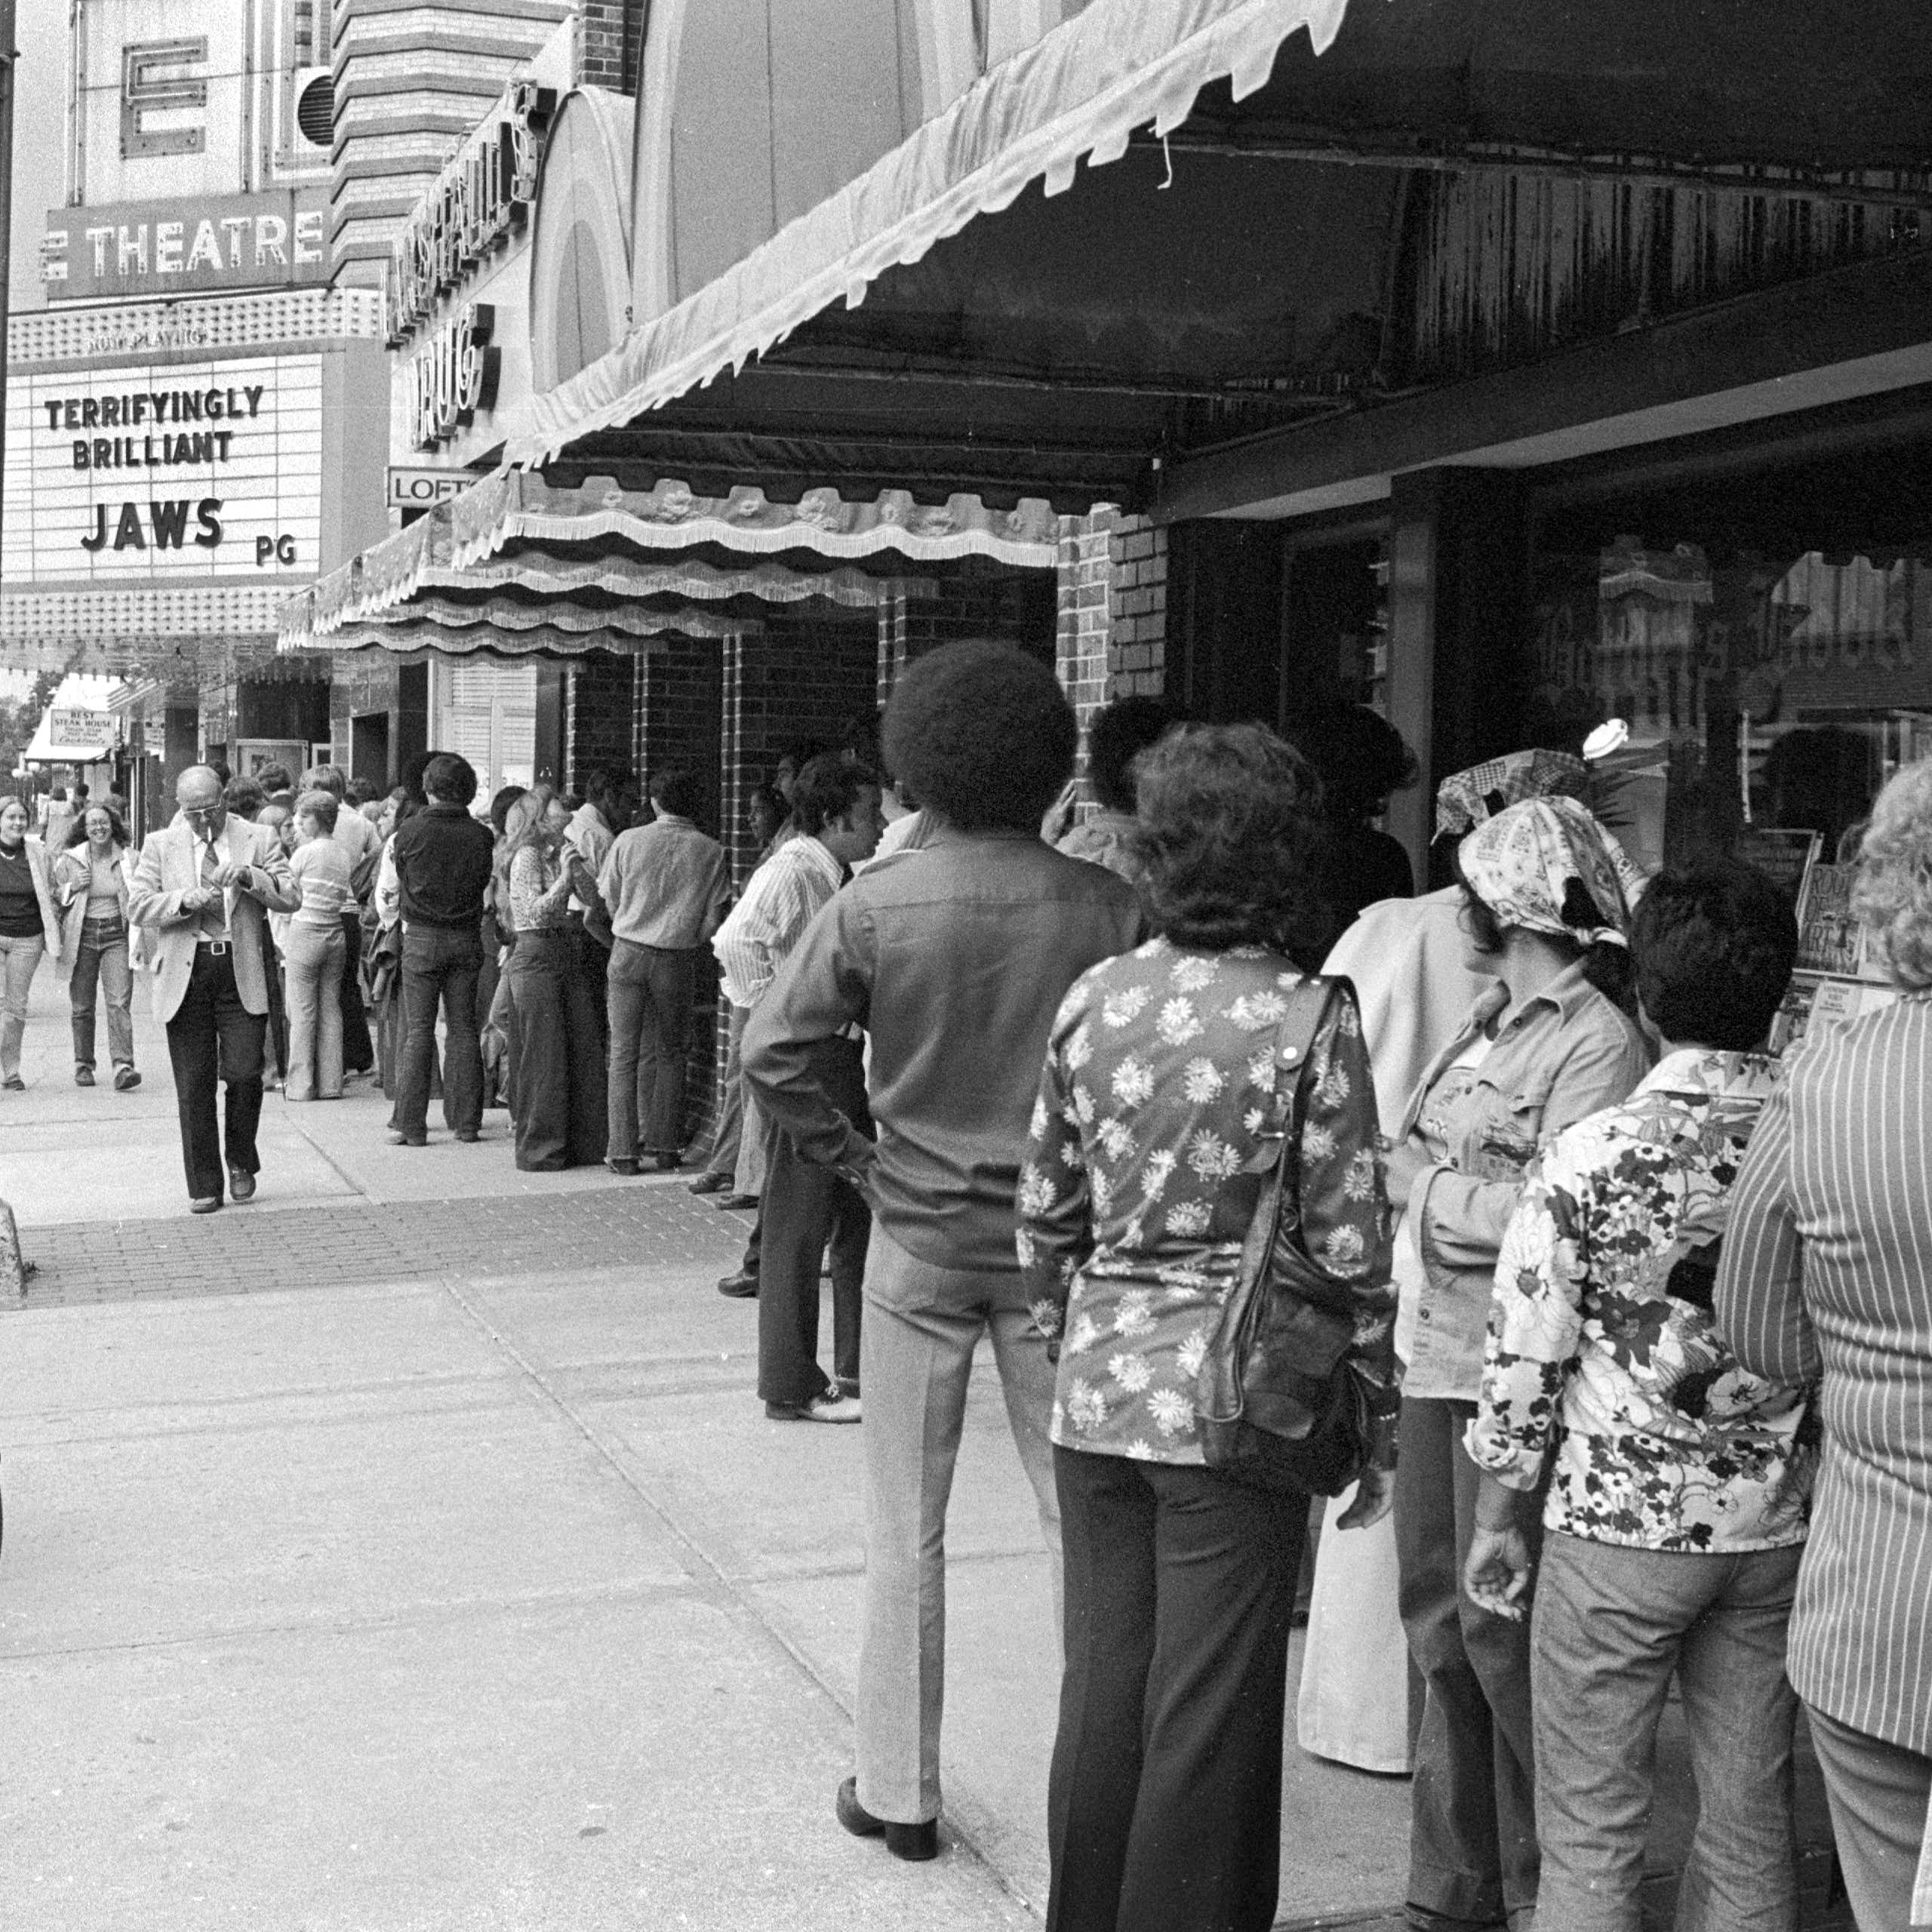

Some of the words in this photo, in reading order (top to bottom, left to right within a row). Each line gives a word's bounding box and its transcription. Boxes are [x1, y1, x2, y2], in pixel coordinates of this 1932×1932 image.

[119, 35, 208, 160] E
[85, 211, 323, 277] THEATRE
[404, 303, 477, 450] DRUG
[45, 385, 263, 430] TERRIFYINGLY
[72, 431, 233, 470] BRILLIANT
[81, 497, 225, 552] JAWS
[255, 534, 297, 566] PG
